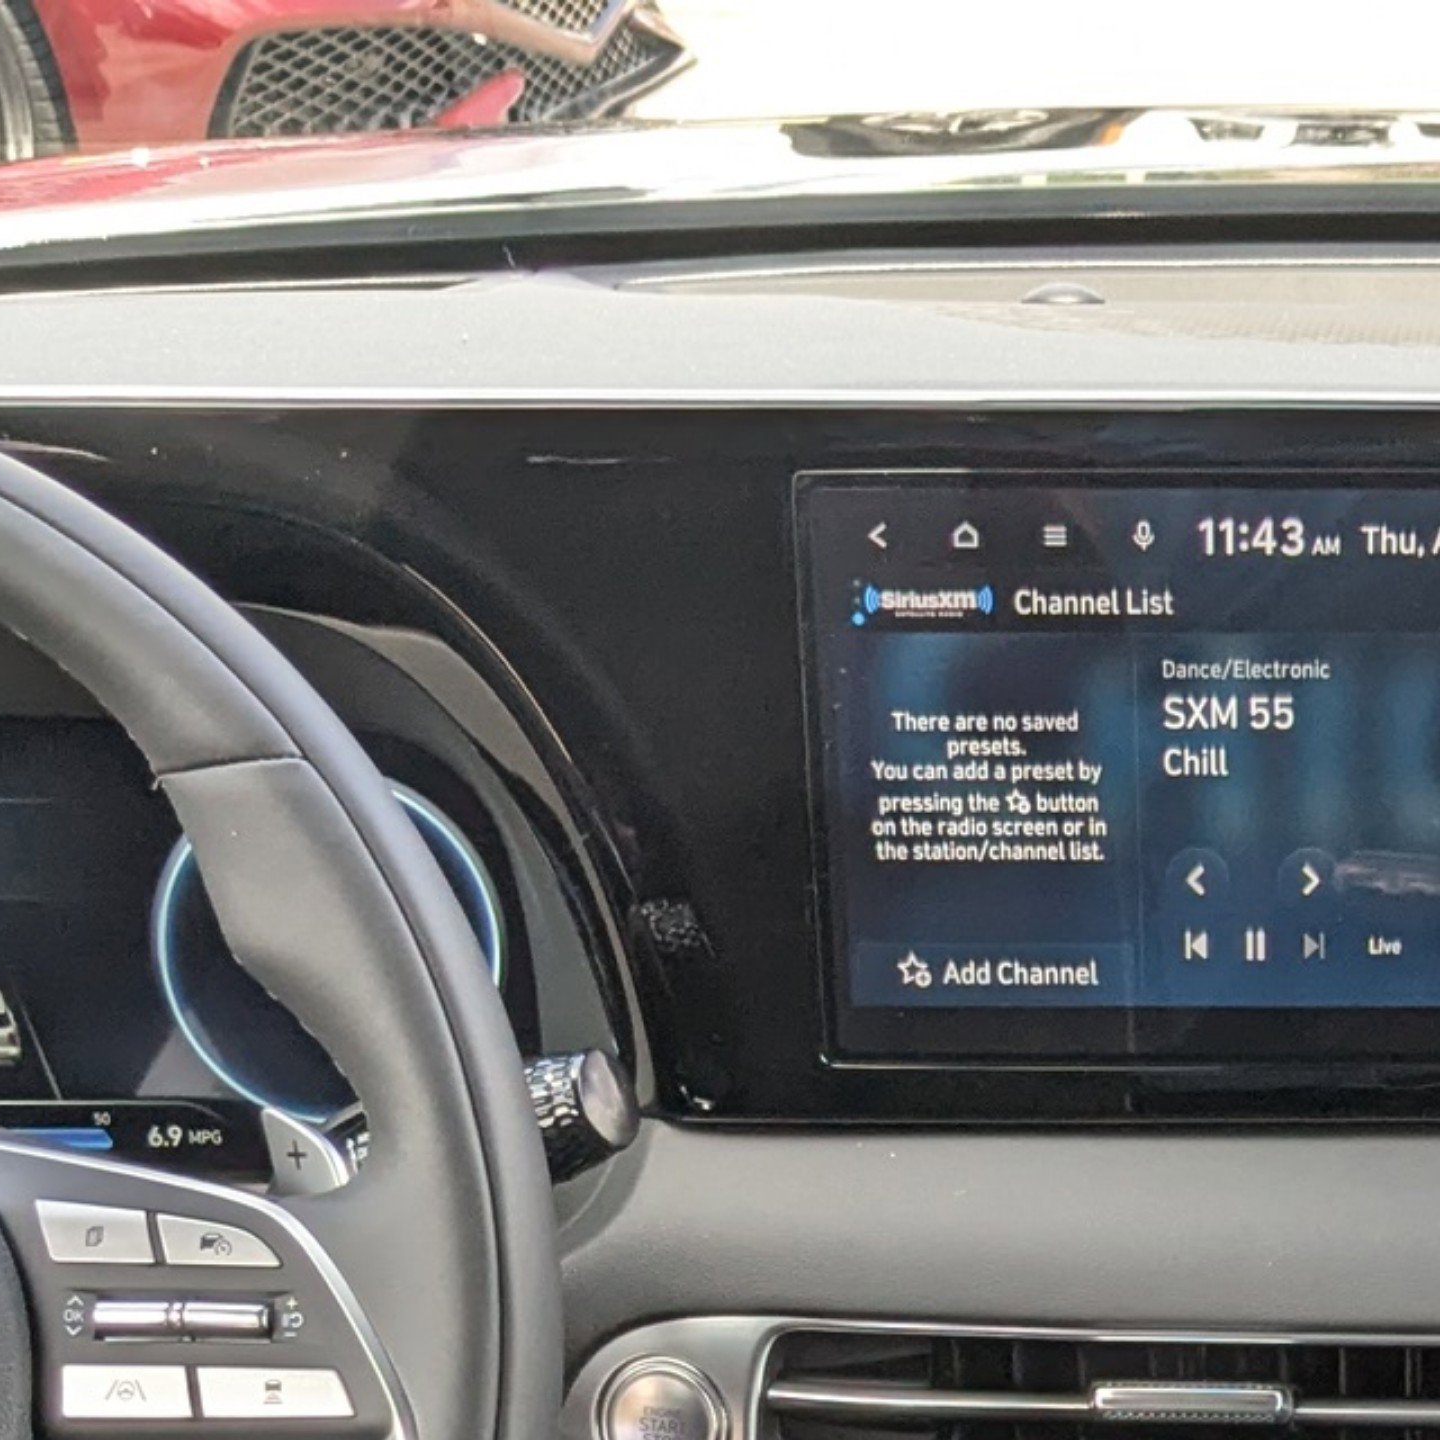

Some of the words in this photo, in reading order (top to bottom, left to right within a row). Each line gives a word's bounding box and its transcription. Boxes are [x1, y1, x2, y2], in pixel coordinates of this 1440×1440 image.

[1198, 516, 1305, 557] 11:43
[1311, 534, 1342, 556] AM
[1361, 523, 1426, 559] Thu,
[1013, 588, 1119, 616] Channel
[1127, 588, 1174, 616] List
[1162, 658, 1331, 681] Dance/Electronic
[891, 710, 950, 732] There
[955, 714, 988, 732] are
[993, 715, 1018, 732] no
[1021, 710, 1079, 732] saved
[1163, 696, 1238, 731] SXM
[1249, 695, 1295, 731] 55
[946, 737, 1027, 759] presets.
[871, 760, 908, 780] You
[913, 764, 948, 780] can
[953, 760, 989, 780] add
[994, 764, 1006, 780] a
[1011, 761, 1075, 783] preset
[1078, 760, 1103, 784] by
[1163, 748, 1229, 778] Chill
[878, 793, 964, 816] pressing
[967, 792, 1000, 812] the
[1036, 791, 1100, 812] button
[871, 820, 896, 837] on
[900, 817, 933, 836] the
[937, 816, 988, 837] radio
[992, 820, 1058, 837] screen
[1062, 820, 1084, 837] or
[1088, 816, 1107, 837] in
[876, 841, 908, 861] the
[913, 840, 1065, 862] station/channel
[1069, 840, 1105, 861] list.
[1367, 937, 1402, 956] Live
[943, 962, 991, 988] Add
[996, 961, 1099, 988] Channel
[147, 1125, 183, 1147] 6.9
[188, 1130, 223, 1147] MPG
[63, 1310, 85, 1323] OK
